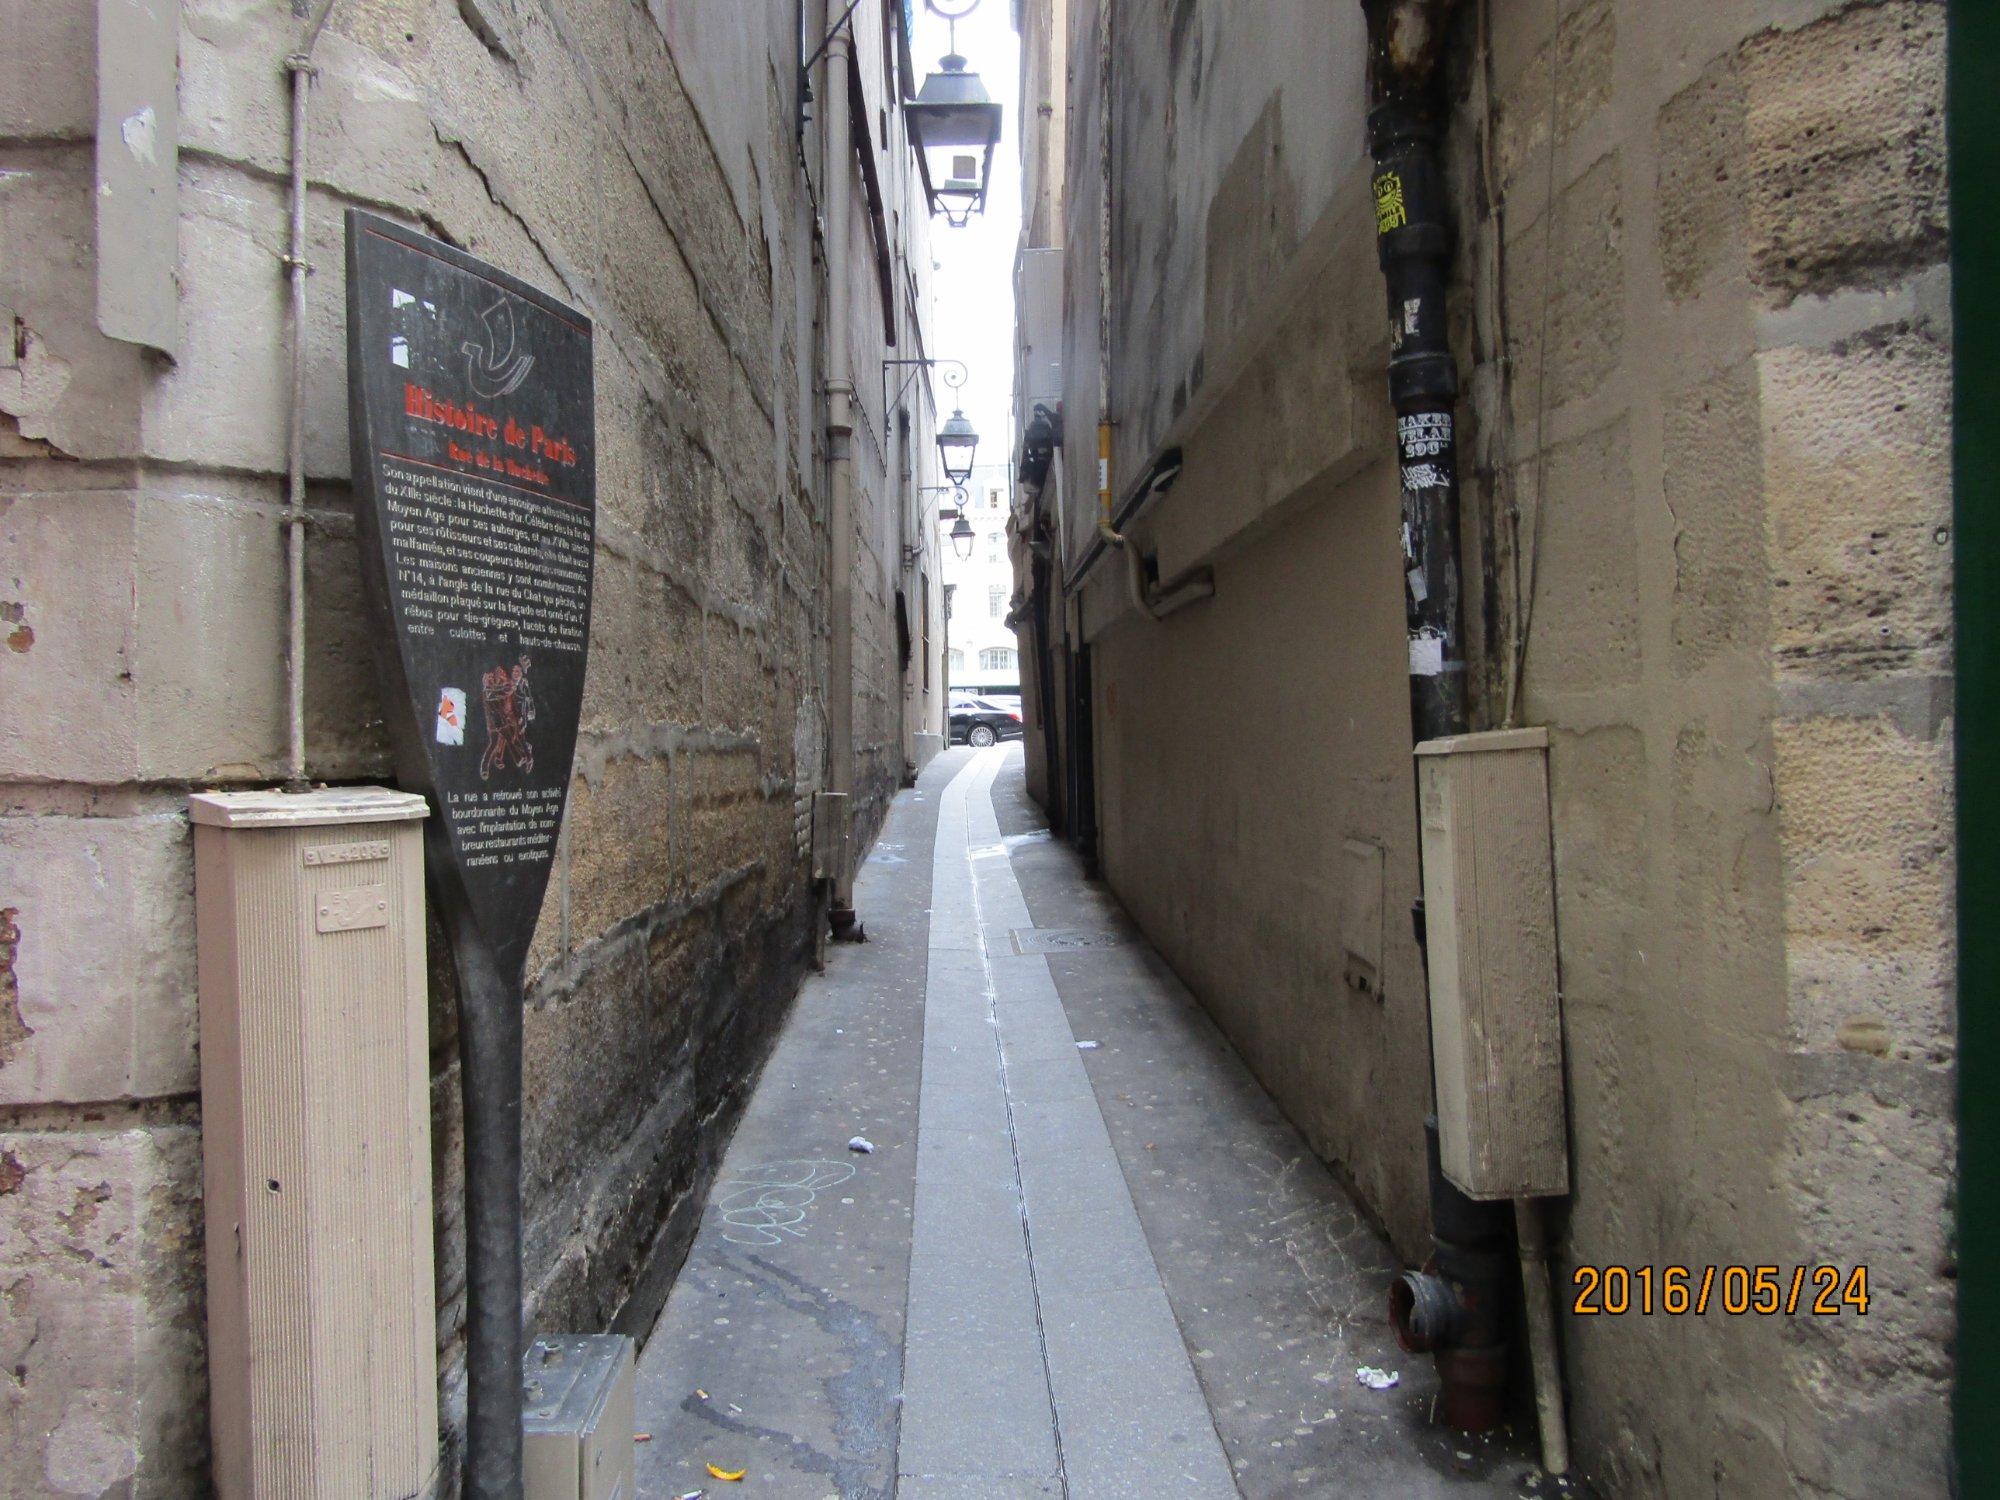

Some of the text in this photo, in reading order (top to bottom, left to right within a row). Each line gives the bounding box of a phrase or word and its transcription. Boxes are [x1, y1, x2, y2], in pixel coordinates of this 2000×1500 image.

[405, 382, 577, 467] Histoire de Paris
[448, 440, 472, 463] Rue
[382, 463, 403, 480] Son
[405, 468, 461, 496] appellation
[463, 482, 484, 498] vient
[485, 488, 507, 504] d'une
[385, 480, 397, 495] du
[457, 497, 465, 510] la
[468, 499, 506, 519] Huchette
[387, 499, 421, 520] Moyen
[425, 507, 444, 525] Age
[448, 514, 469, 529] pour
[473, 519, 488, 530] ses
[491, 521, 529, 543] auberges,
[390, 519, 414, 535] pour
[417, 525, 433, 536] ses
[436, 525, 481, 545] rôtisseurs
[483, 535, 492, 547] et
[493, 540, 507, 550] ses
[446, 544, 455, 556] et
[457, 549, 472, 559] ses
[396, 551, 415, 566] Les
[419, 555, 458, 573] maisons
[461, 563, 505, 581] anciennes
[429, 574, 434, 585] à
[438, 574, 468, 593] l'angle
[471, 580, 482, 592] de
[485, 582, 492, 594] la
[496, 586, 509, 597] rue
[402, 586, 448, 604] médaillon
[450, 593, 481, 611] plaqué
[483, 600, 496, 610] sur
[498, 600, 506, 611] la
[508, 600, 534, 617] façade
[404, 604, 432, 618] rébus
[437, 610, 459, 624] pour
[407, 621, 434, 635] entre
[449, 625, 486, 641] culottes
[498, 631, 507, 642] et
[447, 791, 458, 802] La
[464, 793, 477, 801] rue
[482, 793, 487, 801] a
[452, 805, 505, 818] bourdonnante
[509, 805, 518, 815] du
[521, 803, 543, 817] Moyen
[457, 824, 475, 835] avec
[528, 819, 537, 829] de
[461, 838, 484, 850] breux
[485, 835, 526, 848] restaurants
[503, 853, 513, 863] ou
